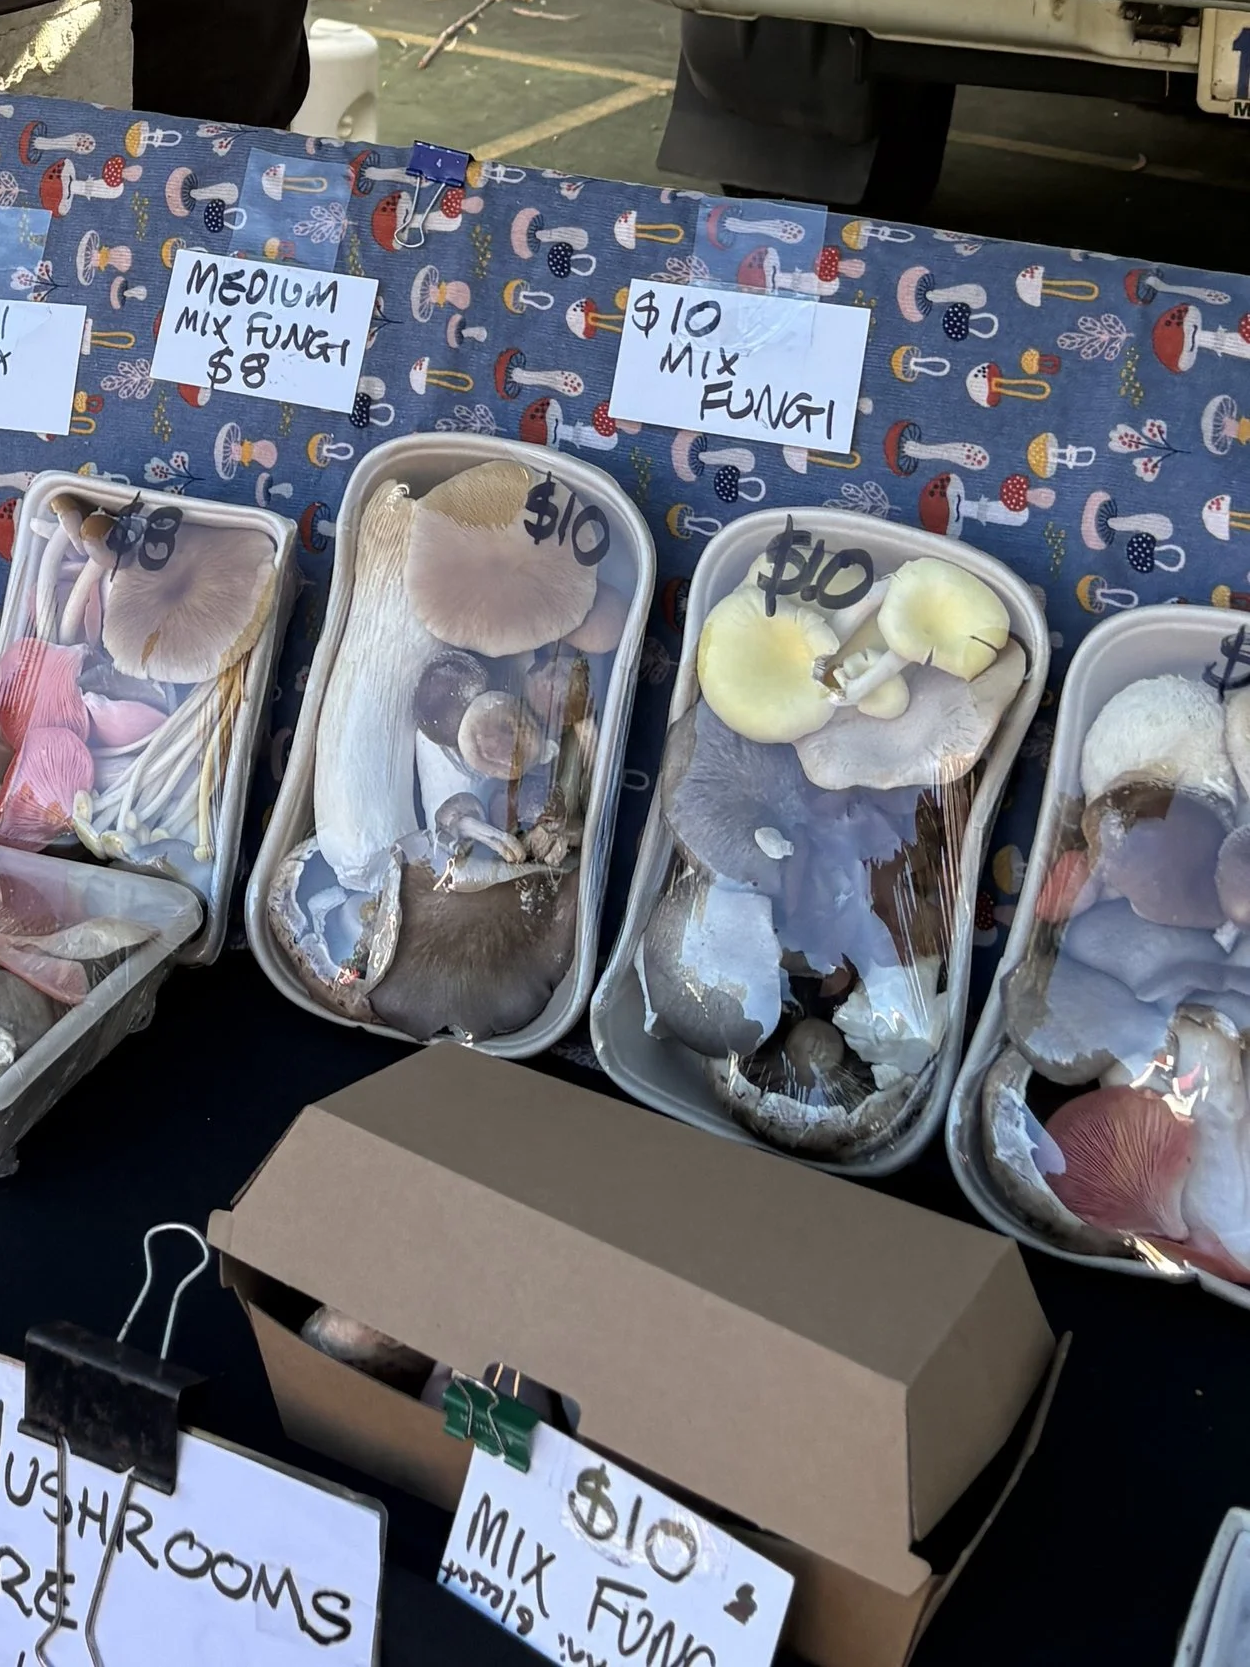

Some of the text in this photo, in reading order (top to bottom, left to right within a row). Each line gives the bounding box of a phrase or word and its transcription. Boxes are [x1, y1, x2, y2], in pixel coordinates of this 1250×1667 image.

[175, 306, 231, 343] MIX
[631, 290, 722, 338] $10
[206, 346, 271, 391] $8
[659, 341, 740, 381] MIX
[700, 380, 836, 441] FUNGI
[524, 471, 612, 568] $10
[758, 515, 875, 617] $10
[567, 1462, 699, 1584] $10
[466, 1491, 557, 1620] MIX
